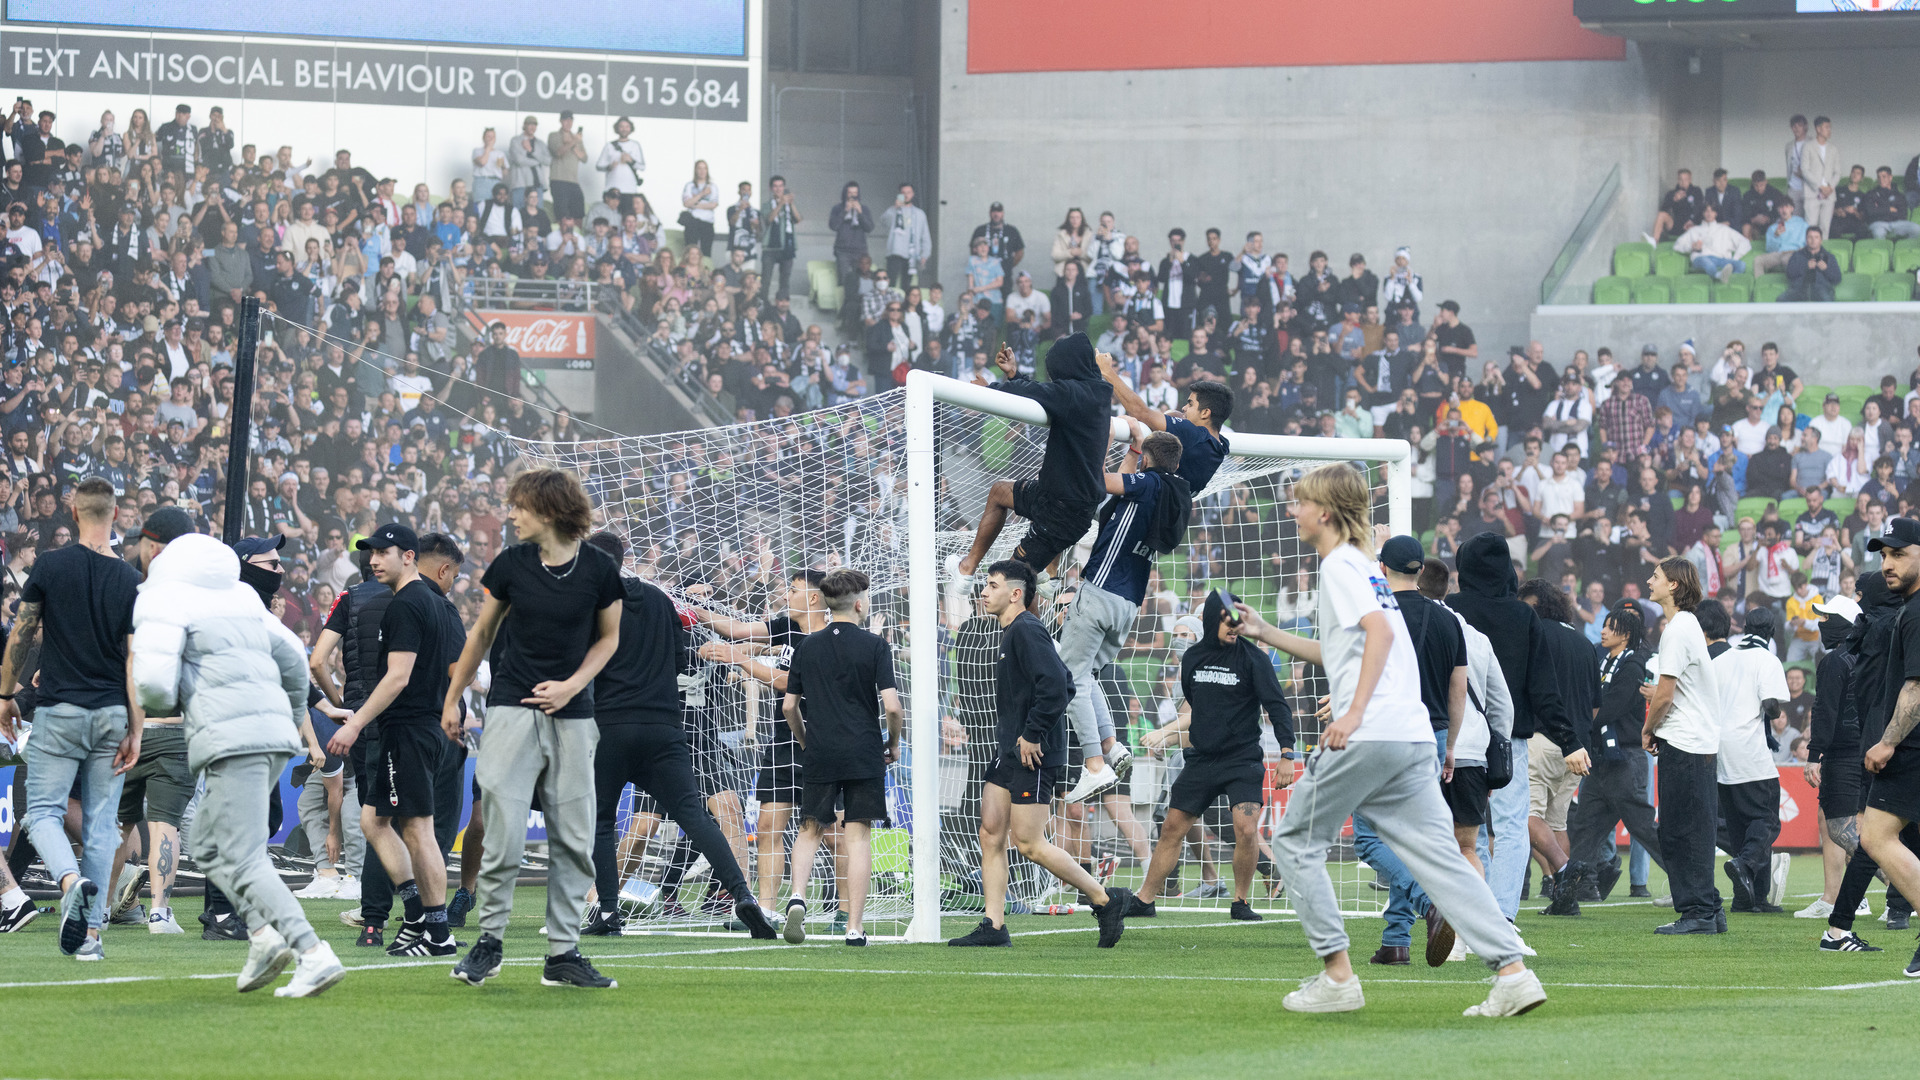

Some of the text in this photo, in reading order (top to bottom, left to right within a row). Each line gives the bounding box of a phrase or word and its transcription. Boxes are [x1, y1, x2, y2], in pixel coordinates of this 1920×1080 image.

[9, 46, 80, 77] TEXT
[90, 49, 284, 87] ANTISOCIAL
[295, 59, 475, 95] BEHAVIOUR
[484, 68, 527, 98] TO
[536, 70, 608, 101] 0481
